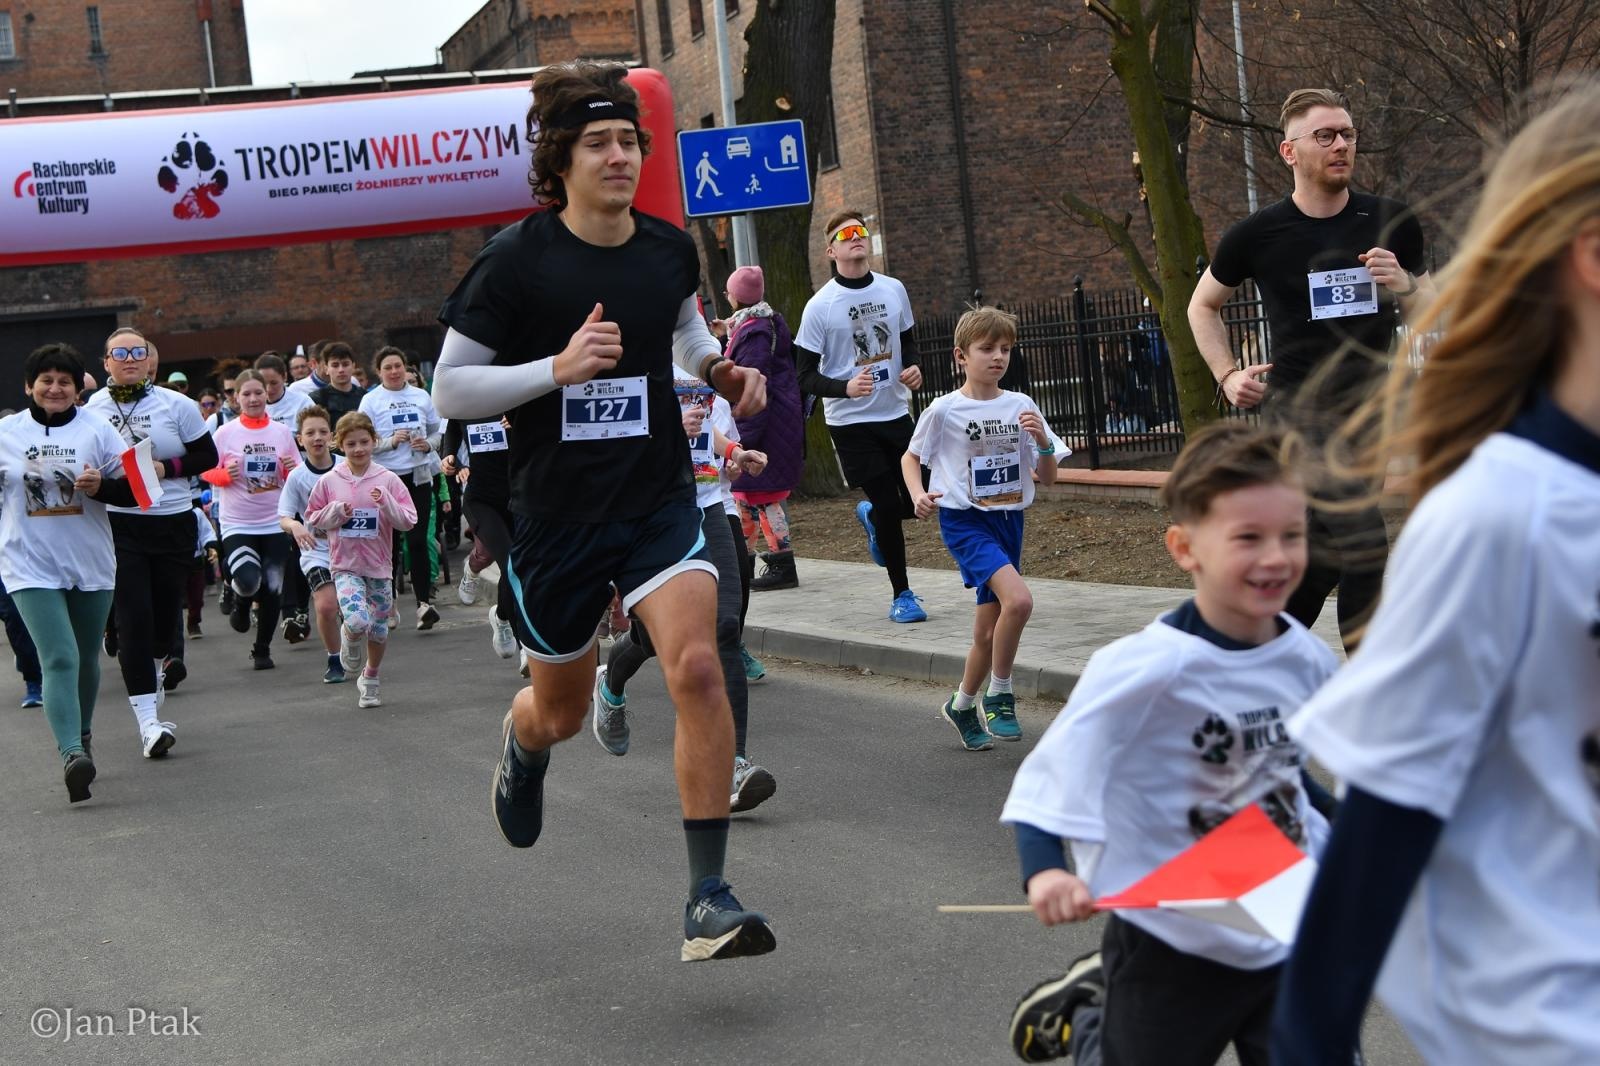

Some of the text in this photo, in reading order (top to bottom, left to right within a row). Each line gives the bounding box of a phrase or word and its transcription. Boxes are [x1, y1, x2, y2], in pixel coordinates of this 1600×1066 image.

[33, 158, 117, 178] Raciborskie
[269, 168, 499, 199] BIEG PAMIĘCI ŻOŁNIERZY WYKLĘTYCH
[38, 196, 89, 215] Kultury
[1331, 285, 1356, 304] 83
[860, 304, 887, 315] WILCZYM
[597, 386, 625, 395] WILCZYM
[584, 398, 629, 422] 127
[983, 423, 1020, 437] WILCZYM
[480, 432, 494, 445] 58
[41, 448, 76, 457] WILCZYM
[256, 462, 270, 472] 37
[991, 467, 1008, 484] 41
[351, 518, 368, 529] 22
[692, 905, 707, 923] N
